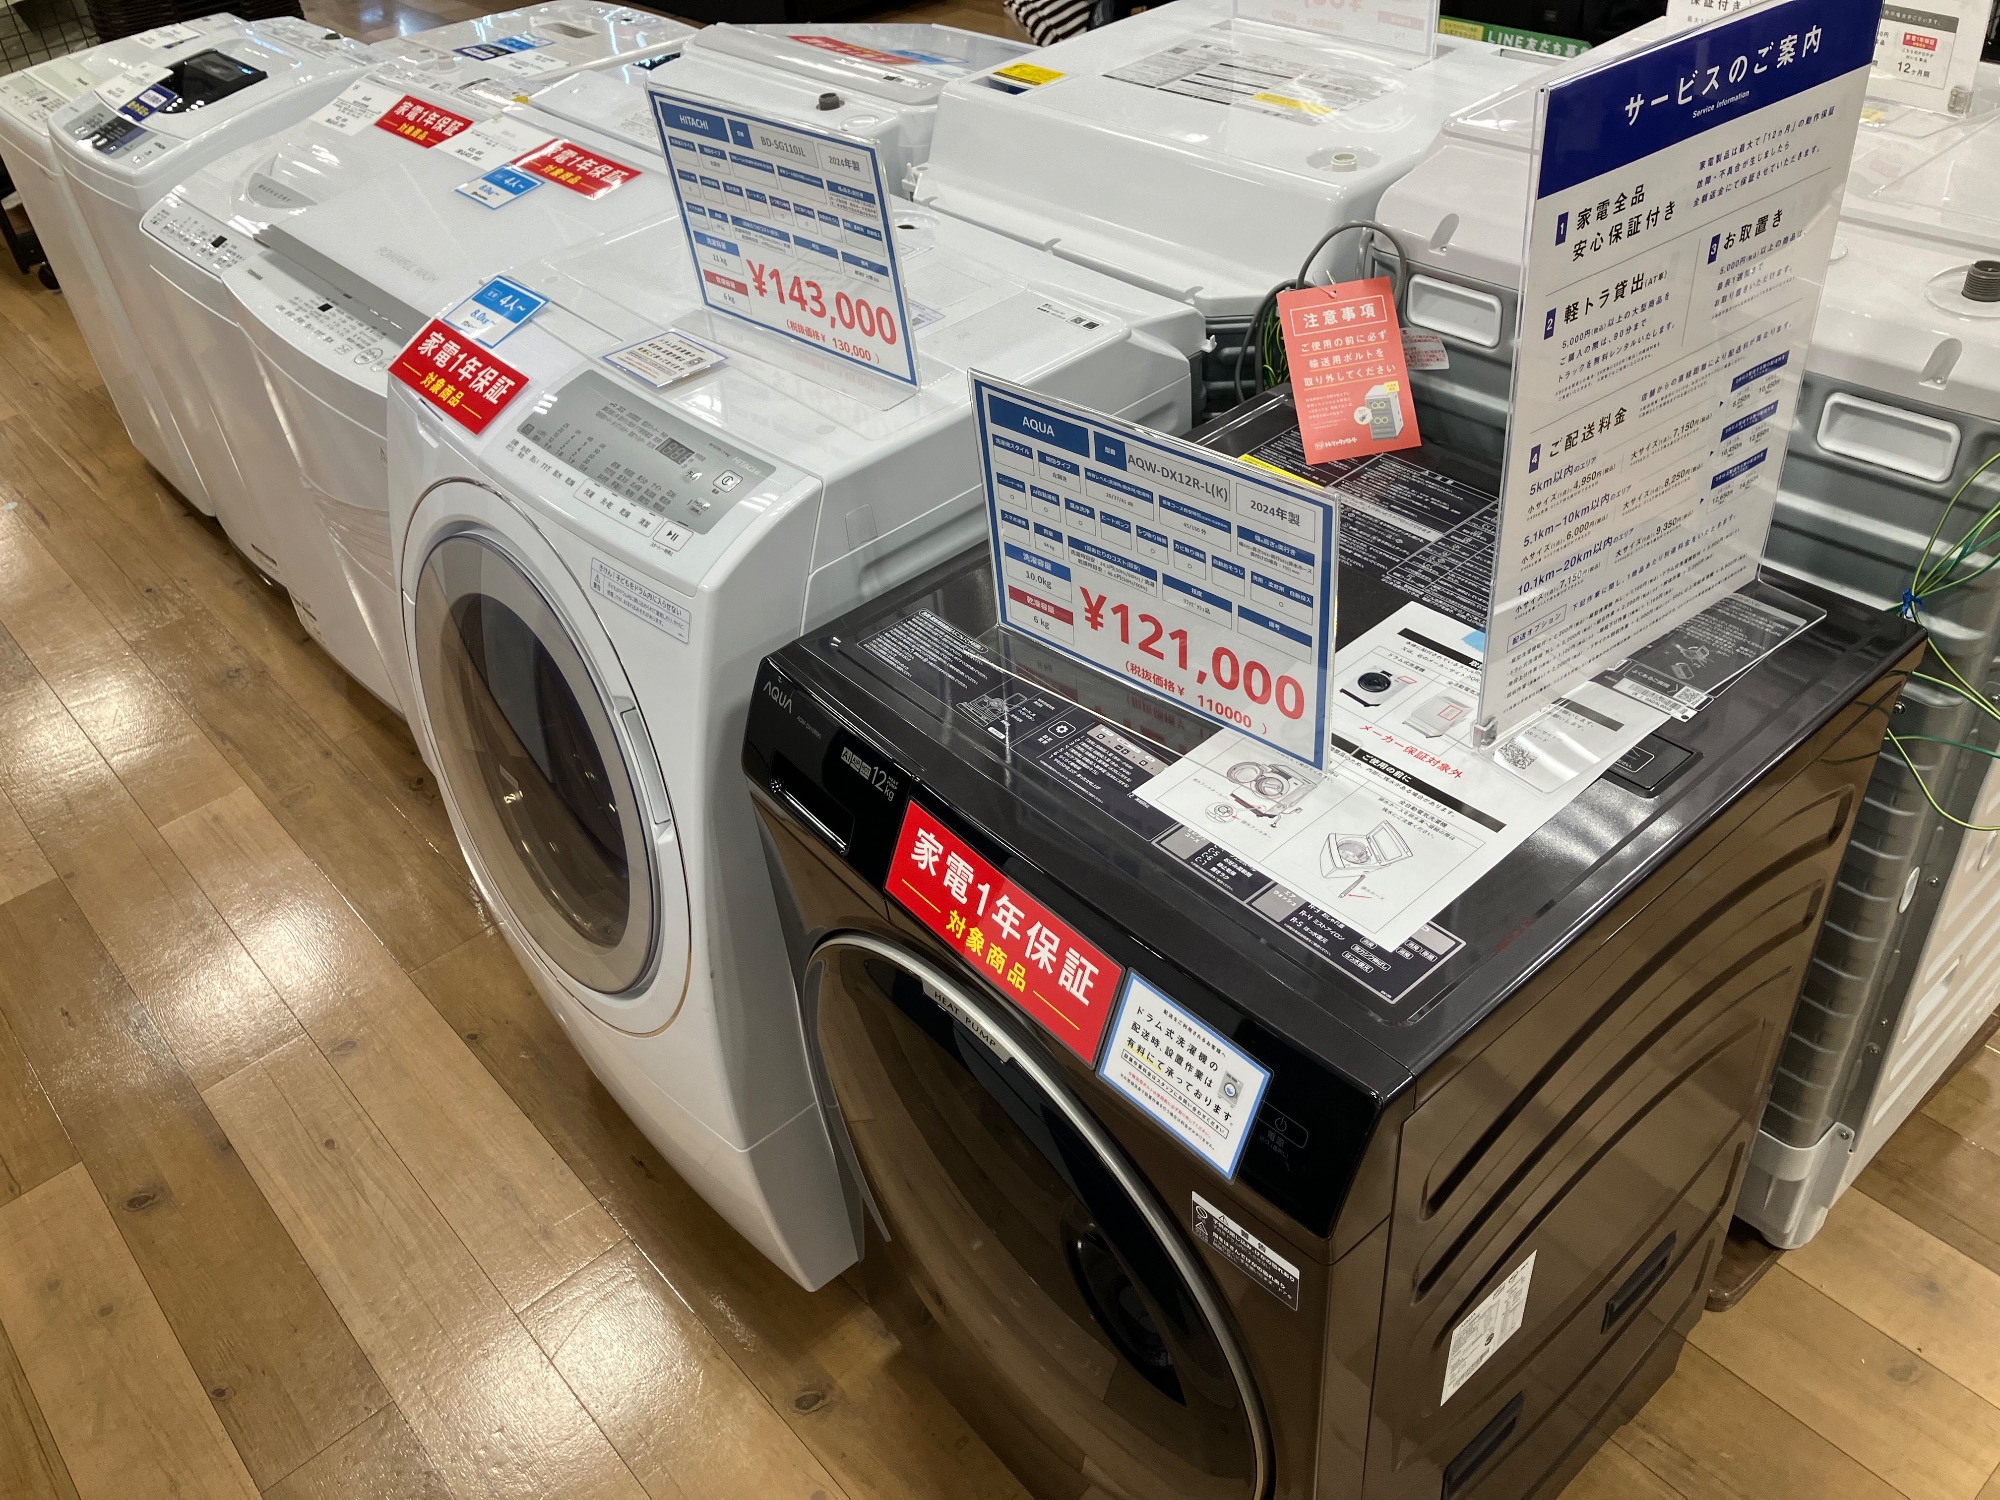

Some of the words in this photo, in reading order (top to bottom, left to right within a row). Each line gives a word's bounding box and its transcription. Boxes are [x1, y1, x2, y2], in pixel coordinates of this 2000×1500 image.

[1621, 21, 1824, 130] サービスのご案内
[394, 100, 464, 139] 家電1年保証
[1691, 101, 1715, 121] Service
[1715, 86, 1751, 110] Information
[678, 113, 709, 131] HITACHI
[759, 135, 806, 158] BD-SG110JL
[827, 153, 861, 172] 2024年製
[1694, 137, 1792, 191] 故障・不具合が生じましたら
[1691, 141, 1823, 209] 全額返金にて保証させていただきます。
[1575, 180, 1647, 233] 家電全品
[1558, 220, 1565, 236] 1
[1571, 197, 1678, 264] 安心保証付き
[1722, 206, 1784, 252] お取置き
[1709, 242, 1717, 256] 3
[745, 258, 898, 346] ¥143,000
[1302, 302, 1376, 329] 注意事項
[1299, 328, 1388, 353] ご使用の前に必ず
[1546, 317, 1553, 332] 2
[417, 330, 517, 405] 家電1年保証
[831, 336, 872, 363] 130,000
[1307, 347, 1385, 369] 輸送用ボルトを
[419, 371, 465, 408] 対象商品
[1302, 362, 1396, 387] 取り外してください
[1021, 414, 1055, 438] AQUA
[1548, 403, 1628, 461] ご配送料金
[733, 456, 762, 476] HITACHI
[1528, 449, 1598, 497] 5km以内のエリア
[1530, 452, 1538, 466] 4
[1127, 452, 1228, 503] AQW-DX12R-L(K)
[1100, 513, 1129, 530] ヒートポンプ
[1249, 496, 1300, 527] 2024年製
[1021, 551, 1052, 572] 洗濯容量
[1024, 569, 1052, 590] 10.0kg
[1025, 594, 1055, 616] 乾燥容量
[1038, 616, 1050, 631] kg
[1511, 609, 1562, 646] 配送オプション
[1079, 585, 1305, 721] ¥121,000
[763, 680, 793, 715] AQUA
[1196, 691, 1252, 730] 110000
[1357, 722, 1467, 780] メーカー保証対象外
[1358, 752, 1415, 783] ご使用の前に
[872, 766, 887, 793] 12
[884, 786, 895, 802] kg
[910, 827, 1100, 1007] 家電1年保証
[945, 910, 1027, 993] 対象商品
[934, 989, 960, 1015] HEAT
[964, 1016, 997, 1048] PUMP
[1130, 1019, 1213, 1089] 配送時、設置作業は
[1135, 1004, 1219, 1073] ドラム式洗濯機の
[1125, 1035, 1235, 1127] 有料にて承っております。
